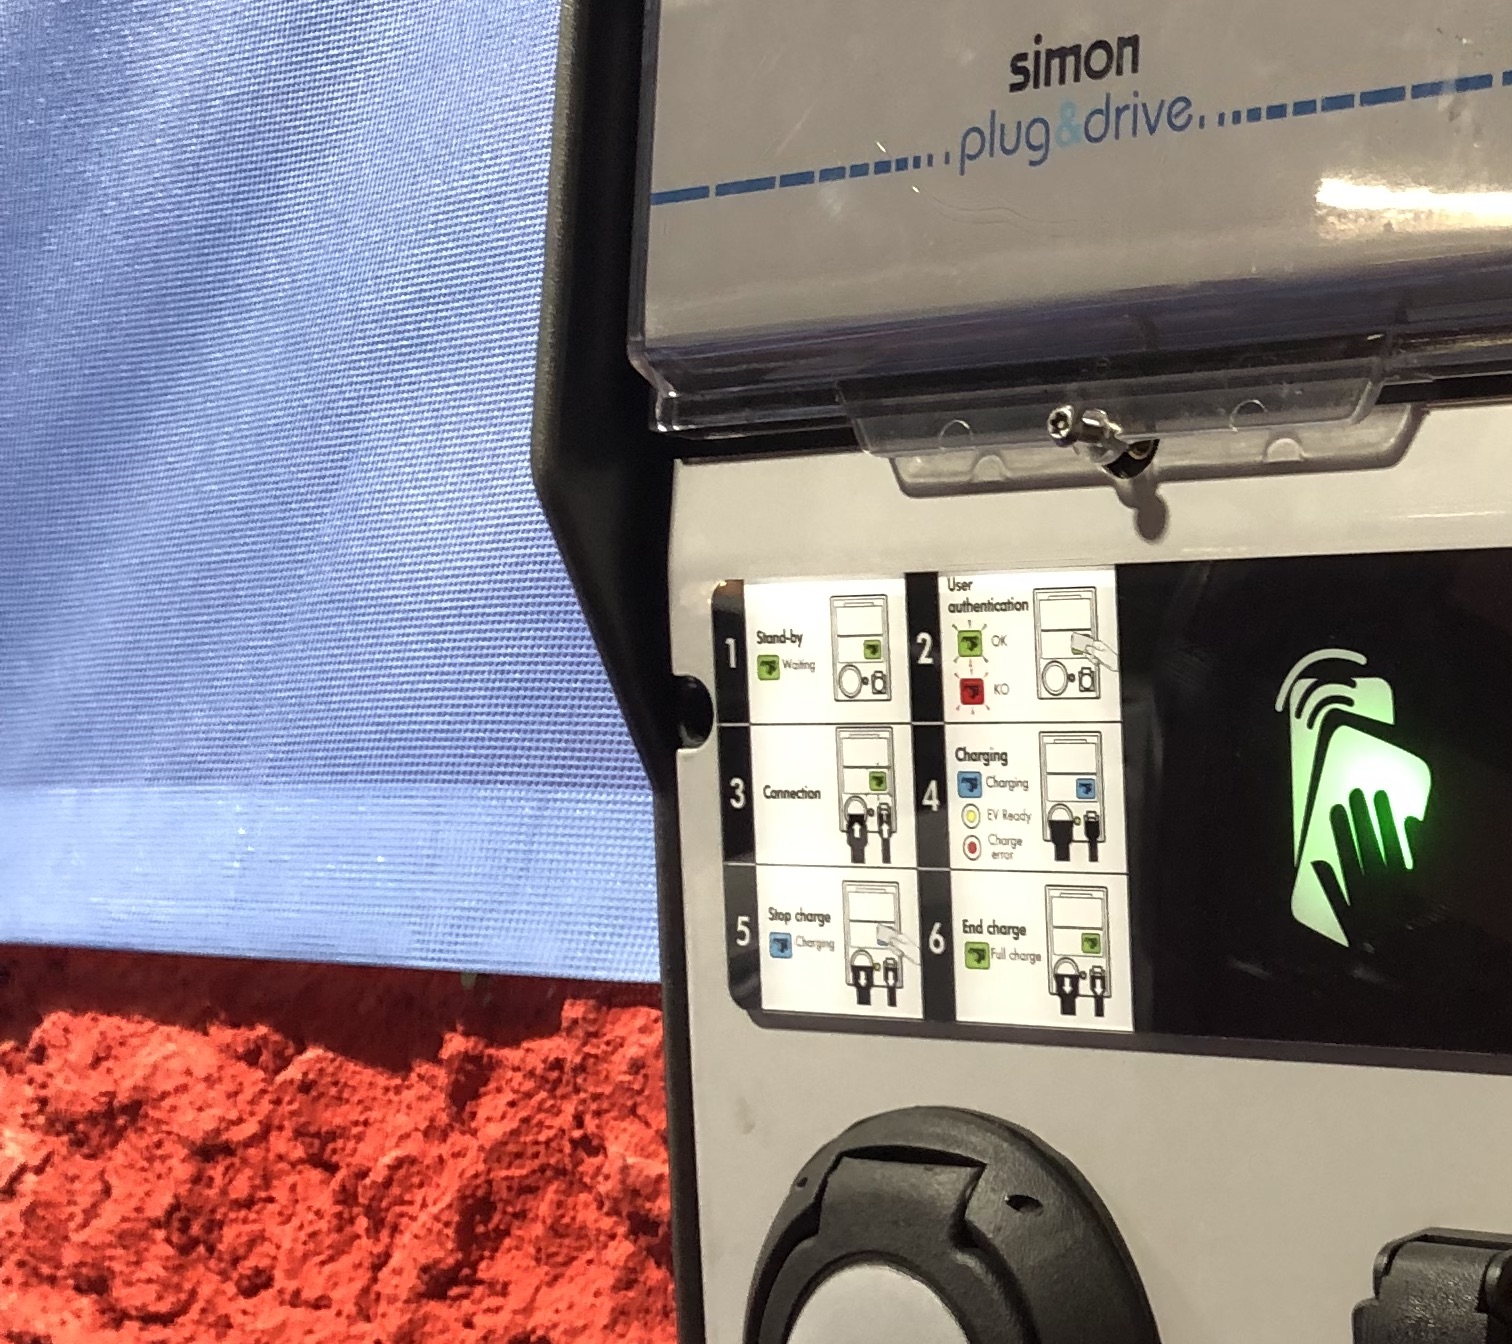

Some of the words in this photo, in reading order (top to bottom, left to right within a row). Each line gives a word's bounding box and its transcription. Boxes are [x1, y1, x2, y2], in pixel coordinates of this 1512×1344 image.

[1008, 32, 1141, 94] simon
[958, 90, 1194, 177] plug&drive
[947, 577, 974, 592] User
[947, 596, 1030, 614] authentication
[756, 628, 804, 648] Stand-by
[990, 634, 1009, 648] OK
[725, 636, 738, 669] 1
[916, 631, 934, 665] 2
[782, 658, 816, 673] Waiting
[993, 682, 1011, 696] KO
[954, 745, 1009, 767] Charging
[762, 784, 822, 800] Connection
[985, 775, 1030, 792] Charging
[729, 777, 747, 810] 3
[921, 779, 941, 812] 4
[986, 808, 999, 822] EV
[1002, 808, 1033, 825] Ready
[987, 832, 1024, 848] Charge
[991, 849, 1015, 861] error
[768, 906, 792, 926] Stop
[795, 906, 832, 928] charge
[736, 915, 751, 947] 5
[928, 921, 946, 955] 6
[962, 918, 984, 935] End
[986, 918, 1028, 941] charge
[795, 934, 836, 953] Charging
[990, 947, 1007, 961] Full
[1008, 947, 1042, 966] charge
